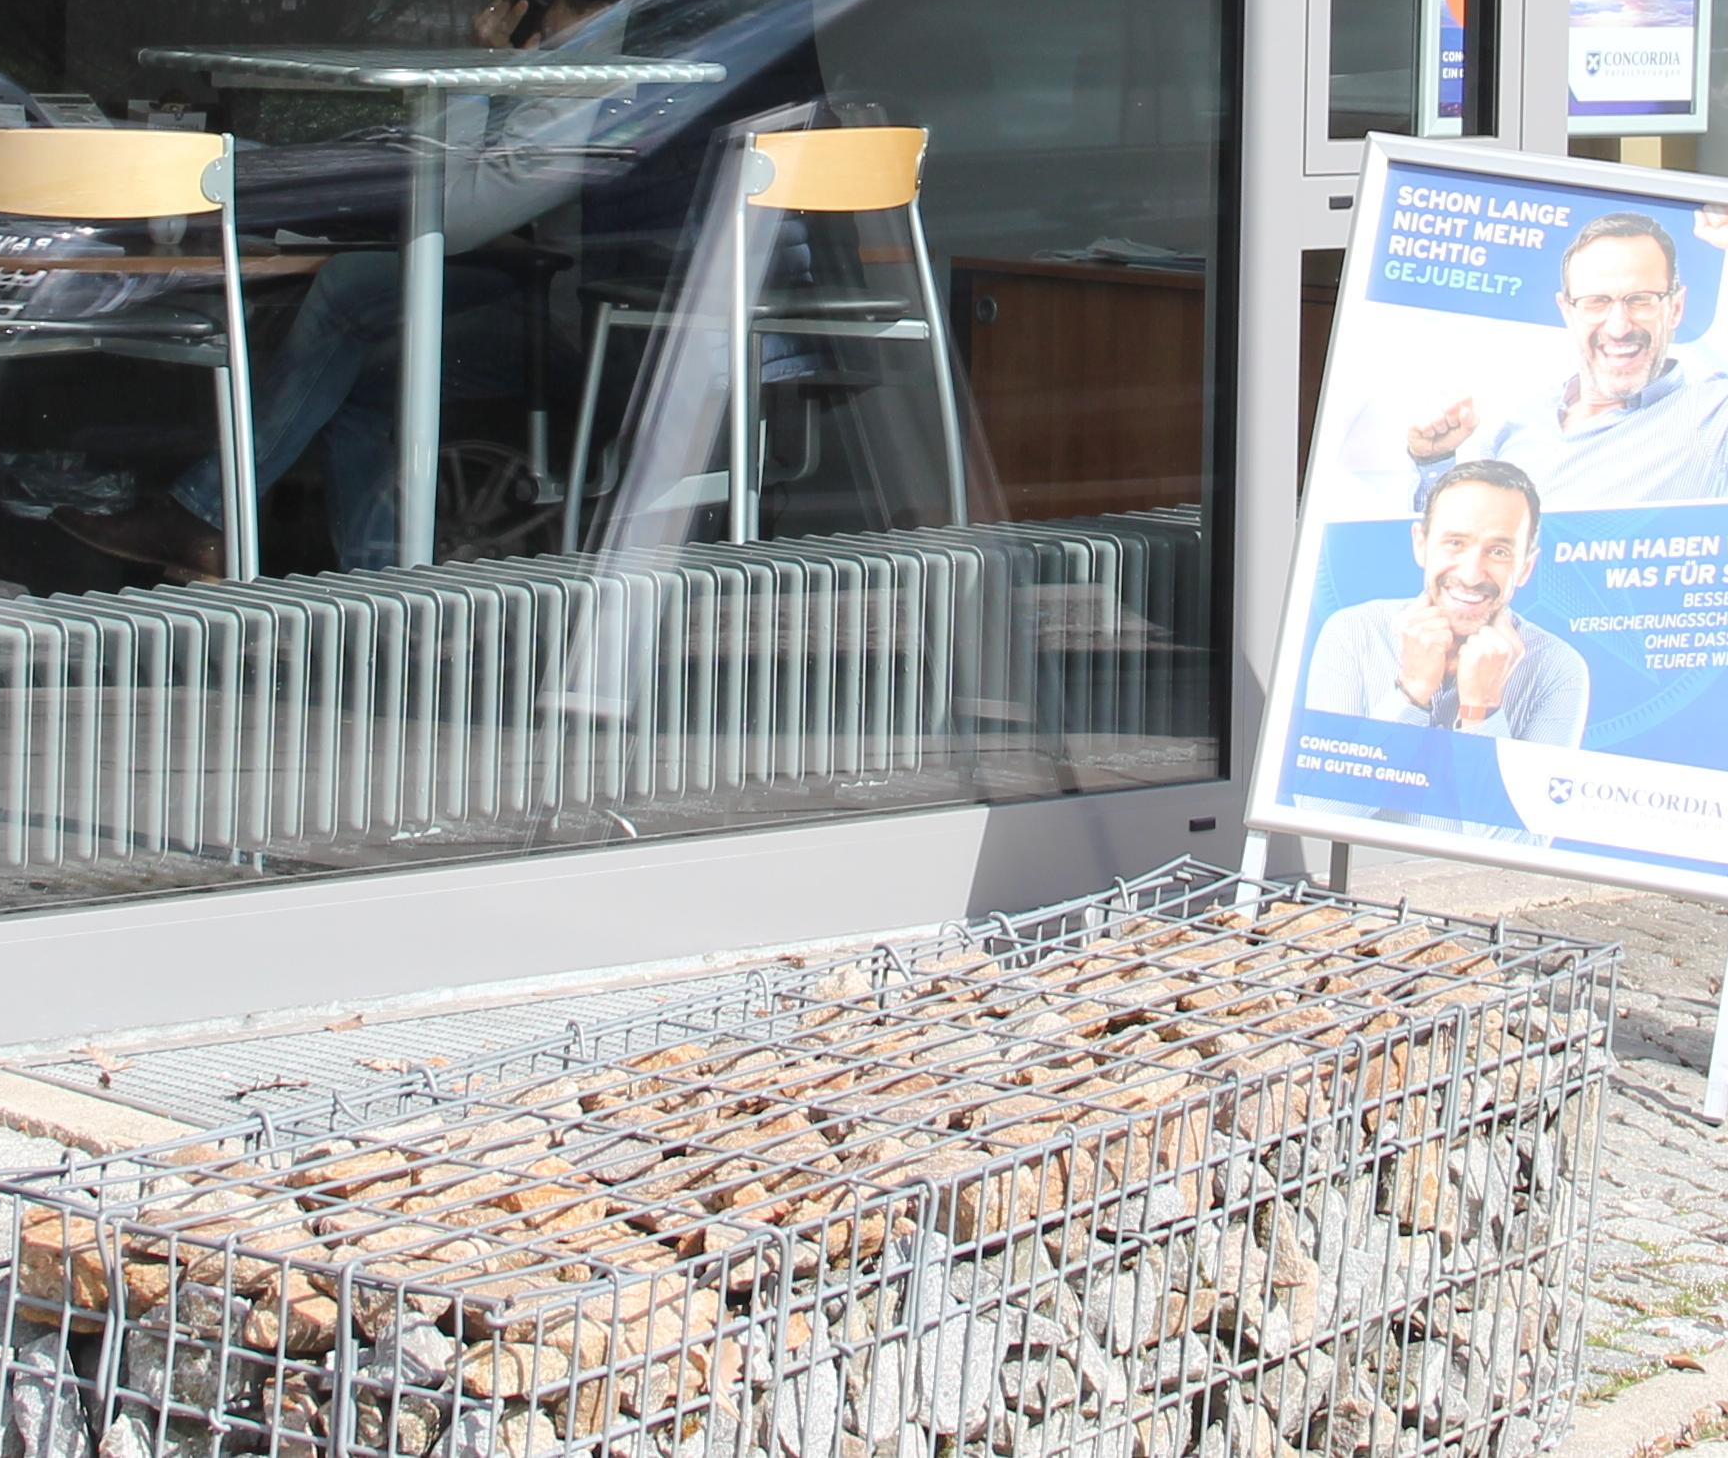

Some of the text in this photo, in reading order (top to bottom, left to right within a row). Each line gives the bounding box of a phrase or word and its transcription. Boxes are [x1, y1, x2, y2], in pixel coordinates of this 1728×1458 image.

[1604, 50, 1681, 66] CONCORDIA
[1397, 185, 1571, 228] SCHON LANGE
[1392, 209, 1545, 250] NICHT MEHR
[1388, 234, 1488, 267] RICHTIG
[1384, 260, 1523, 297] GEJUBELT?
[1554, 539, 1626, 564] DANN
[1632, 535, 1720, 559] HABEN
[1605, 565, 1659, 589] WAS
[1664, 560, 1717, 587] FÜR
[1644, 632, 1690, 650] OHNE
[1644, 653, 1708, 670] TEURER
[1299, 734, 1388, 762] CONCORDIA.
[1296, 754, 1431, 788] EIN GUTER GRUND.
[1580, 780, 1724, 819] CONCORDIA
